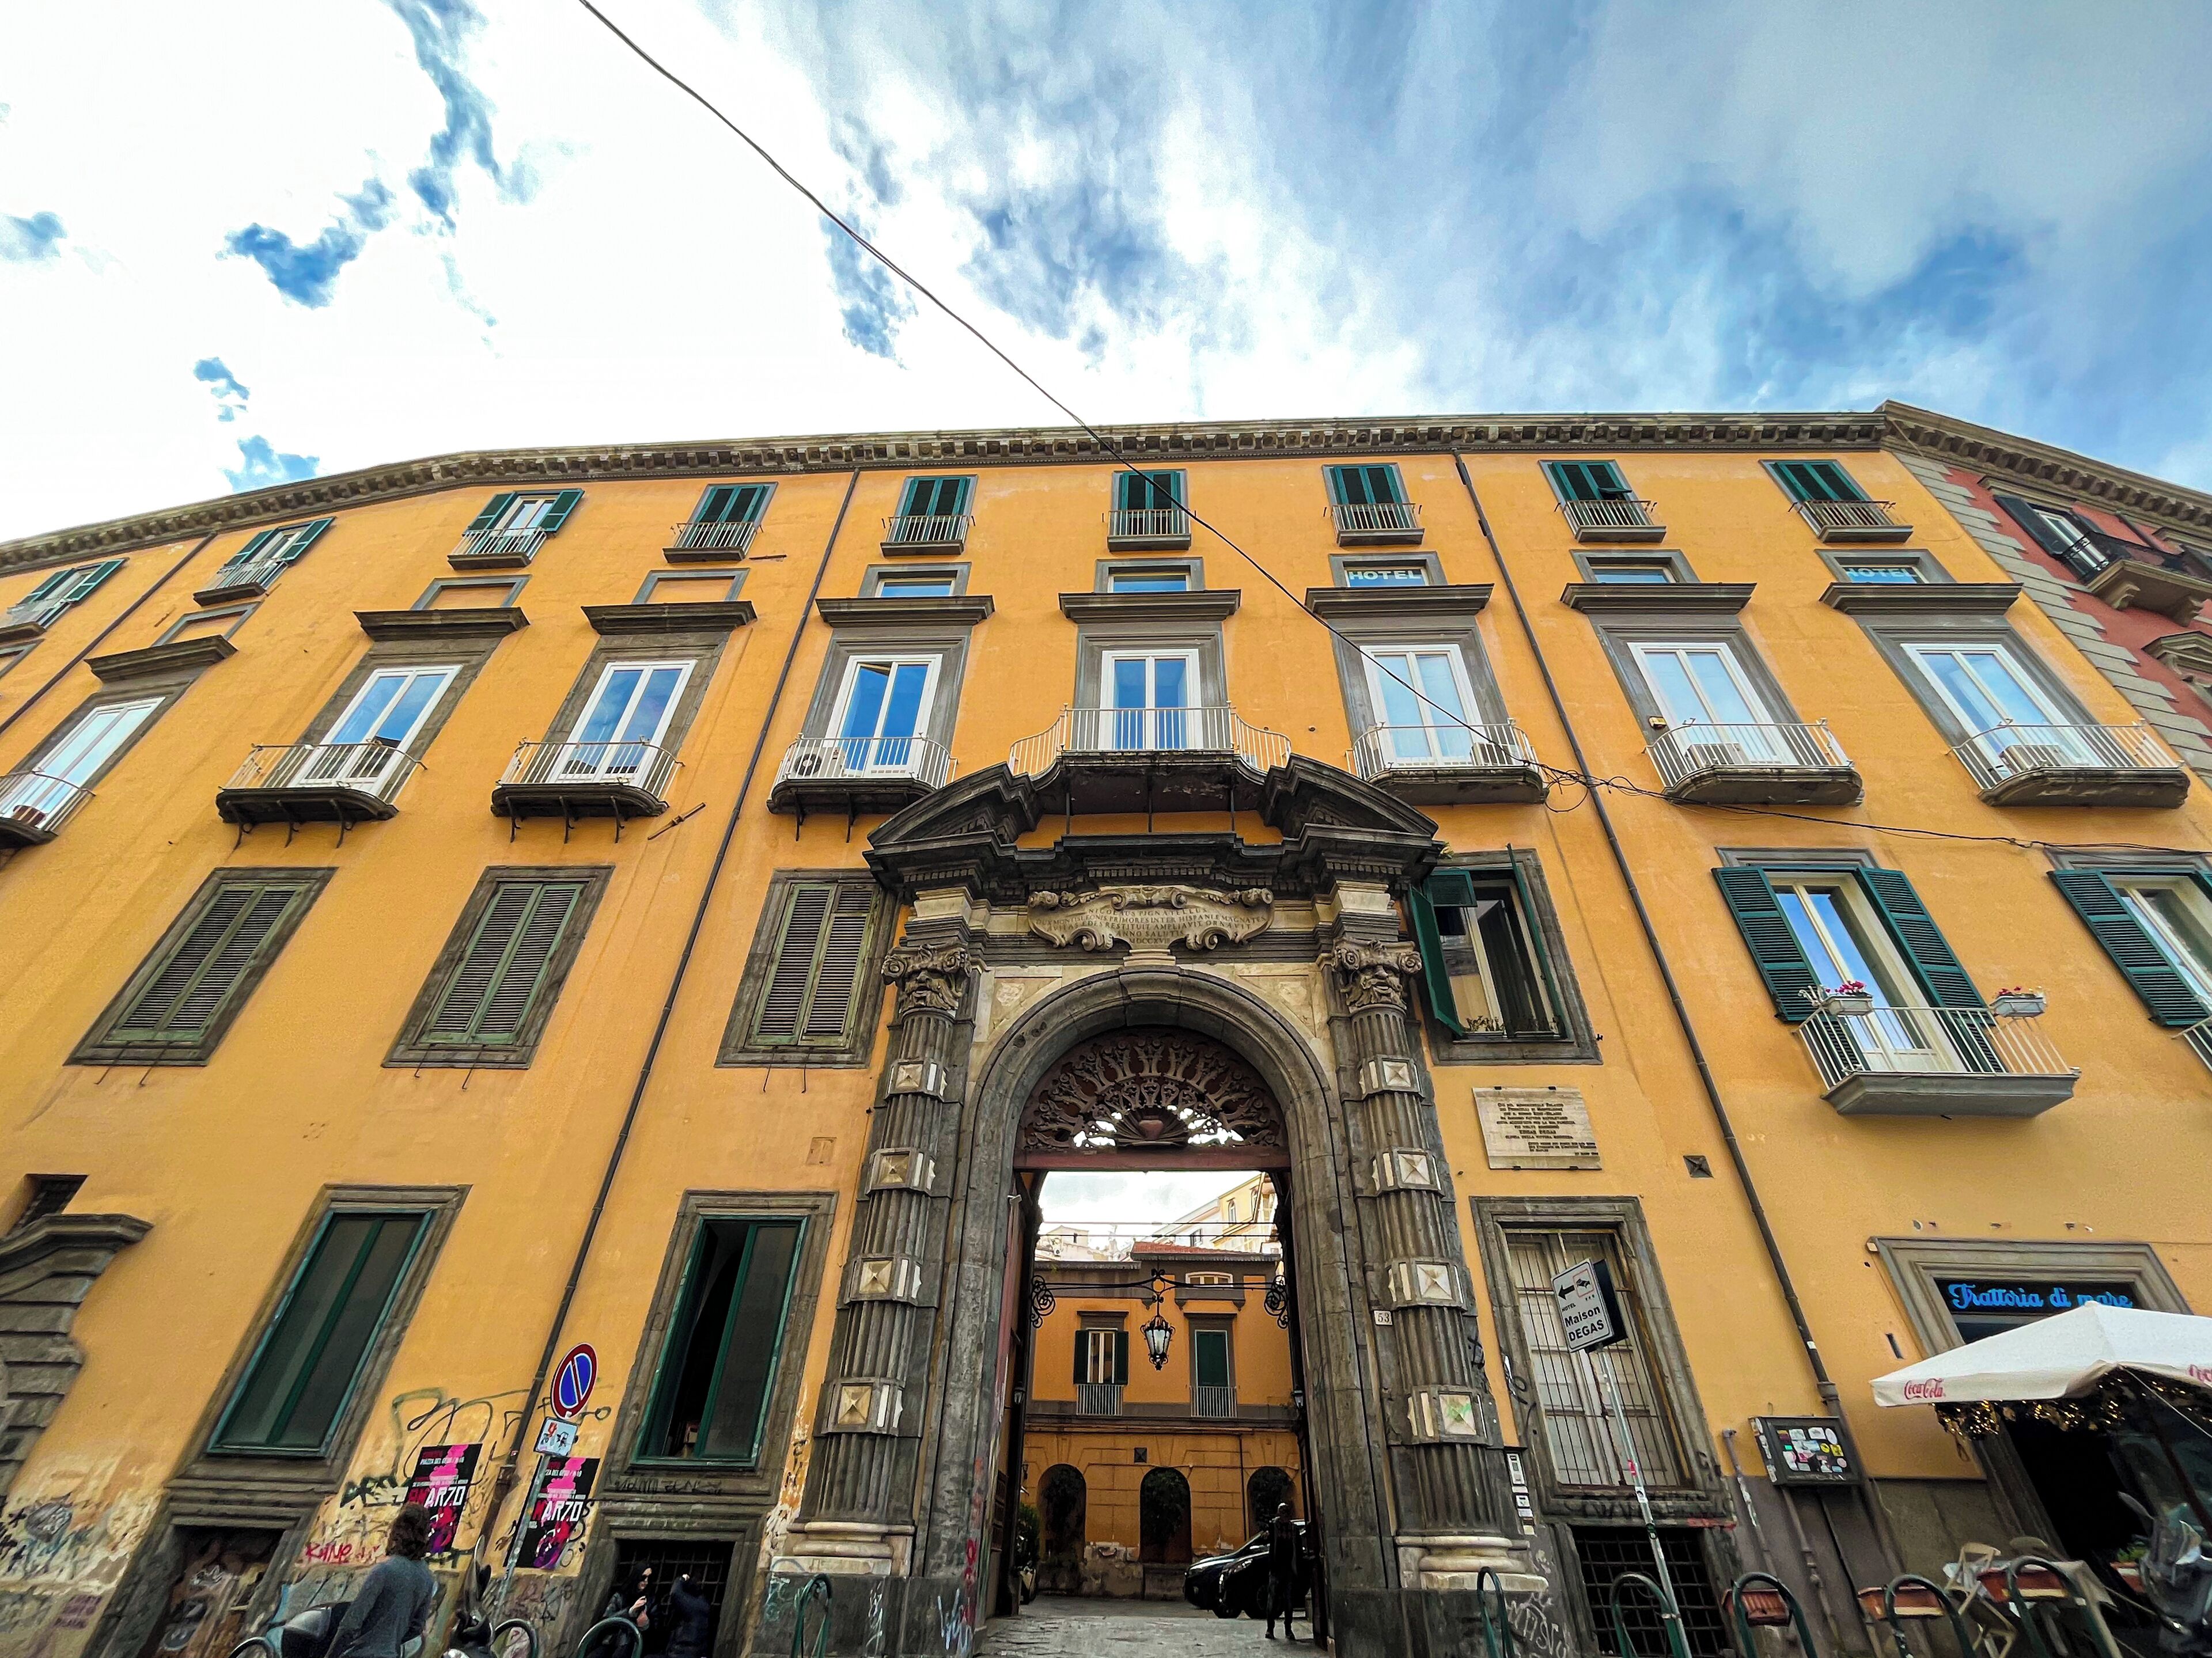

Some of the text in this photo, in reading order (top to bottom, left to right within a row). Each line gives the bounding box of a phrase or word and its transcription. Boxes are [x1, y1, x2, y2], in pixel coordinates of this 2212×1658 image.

[1348, 570, 1422, 580] HOTEL
[1948, 1283, 2044, 1309] Trattoria
[2050, 1287, 2072, 1308] di
[1562, 1303, 1577, 1312] HOTEL
[1377, 1312, 1390, 1323] 53
[1564, 1306, 1601, 1327] Maison
[1568, 1319, 1605, 1342] DEGAS
